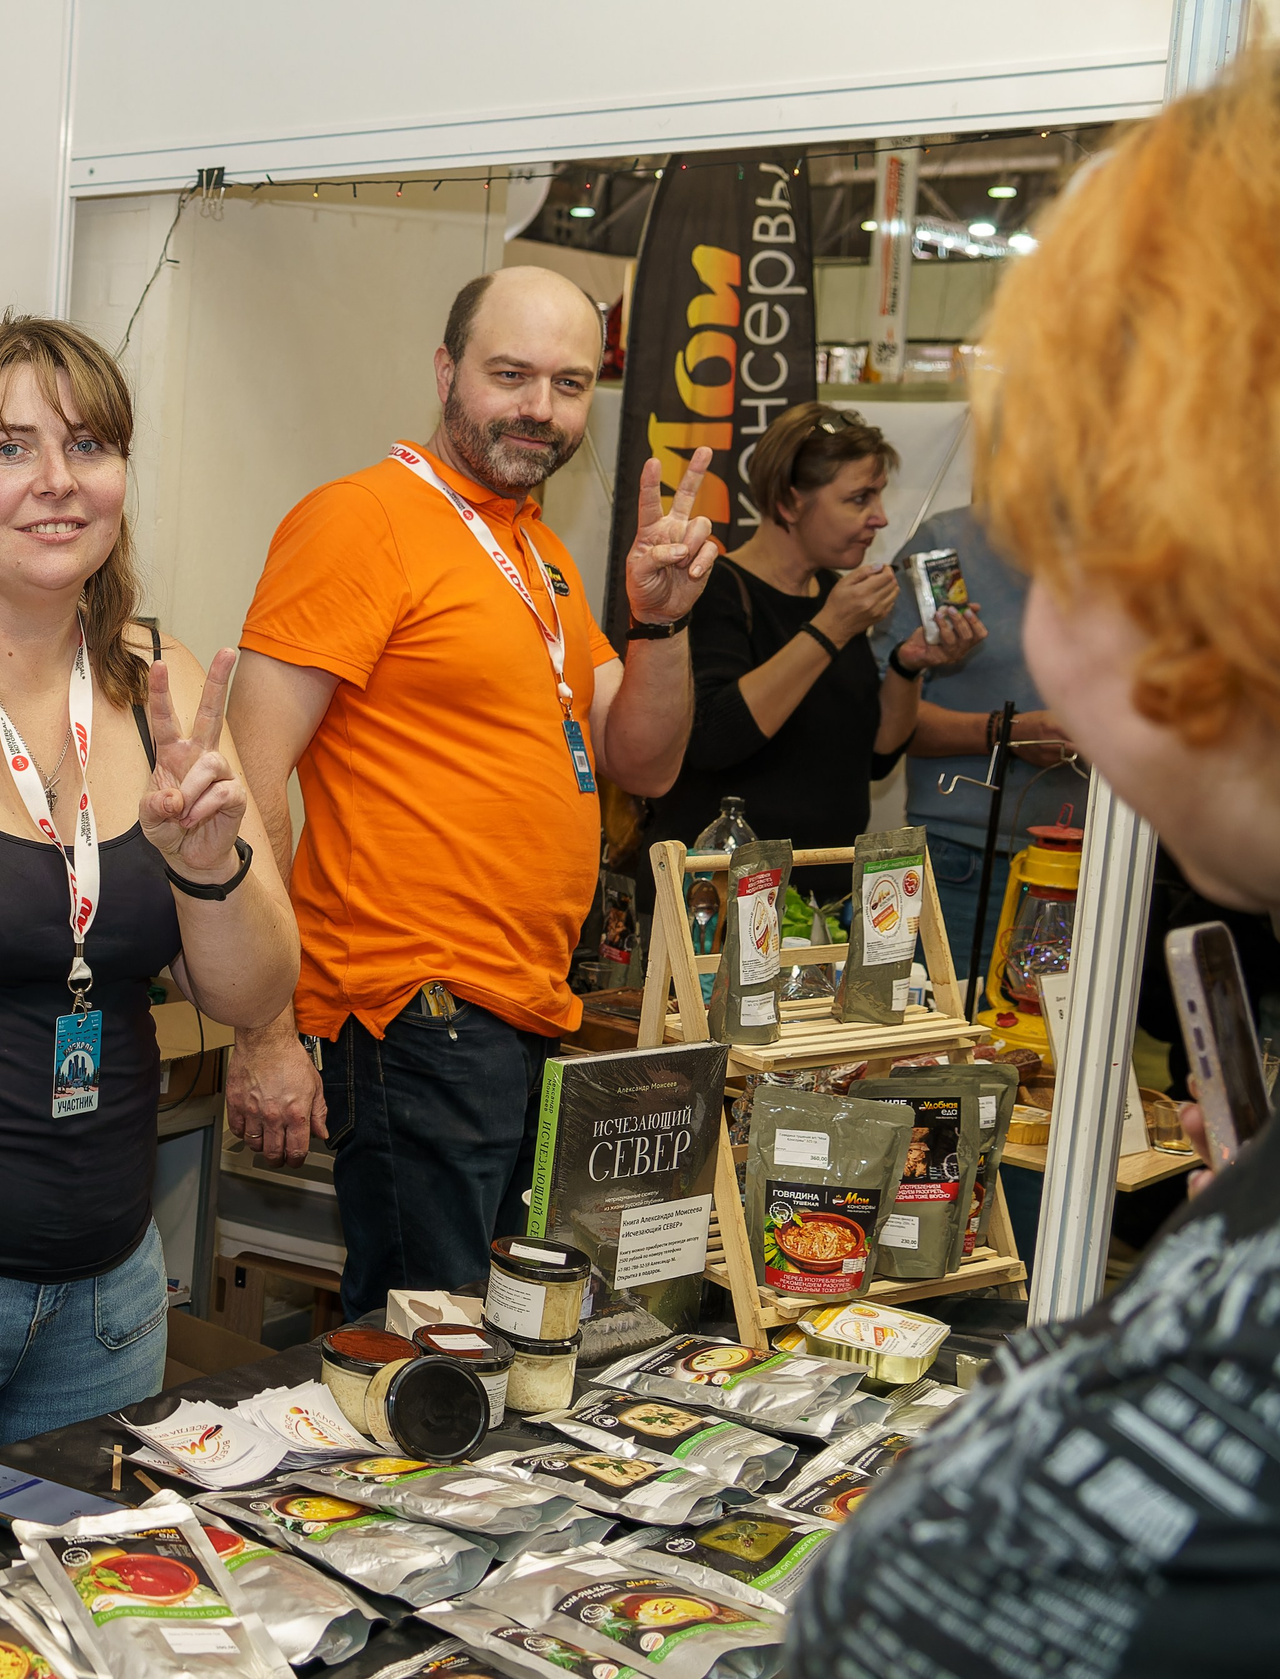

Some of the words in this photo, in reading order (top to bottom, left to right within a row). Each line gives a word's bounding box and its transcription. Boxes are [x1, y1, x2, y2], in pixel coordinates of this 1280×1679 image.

[75, 721, 86, 768] MO
[617, 1083, 649, 1094] Александр
[651, 1081, 678, 1090] Моисеев
[57, 1095, 94, 1114] УЧАСТНИК
[923, 1101, 958, 1110] Удобная
[593, 1105, 692, 1138] ИСЧЕЗАЮЩИЙ
[588, 1130, 691, 1182] СЕВЕР
[532, 1119, 551, 1216] ИСЧЕЗАЮЩИЙ
[773, 1189, 819, 1201] ГОВЯДИНА
[842, 1192, 870, 1205] Мои
[623, 1219, 639, 1227] Книга
[641, 1212, 674, 1223] Александра
[675, 1206, 702, 1216] Моисеева
[622, 1225, 662, 1238] «Исчезающий
[663, 1222, 683, 1230] СЕВЕР»
[780, 1278, 822, 1287] РЕКОМЕНДУЕМ
[758, 1569, 782, 1587] ГОТОВЫЙ
[781, 1560, 792, 1570] СУП
[793, 1537, 818, 1562] РАЗОГРЕЛ
